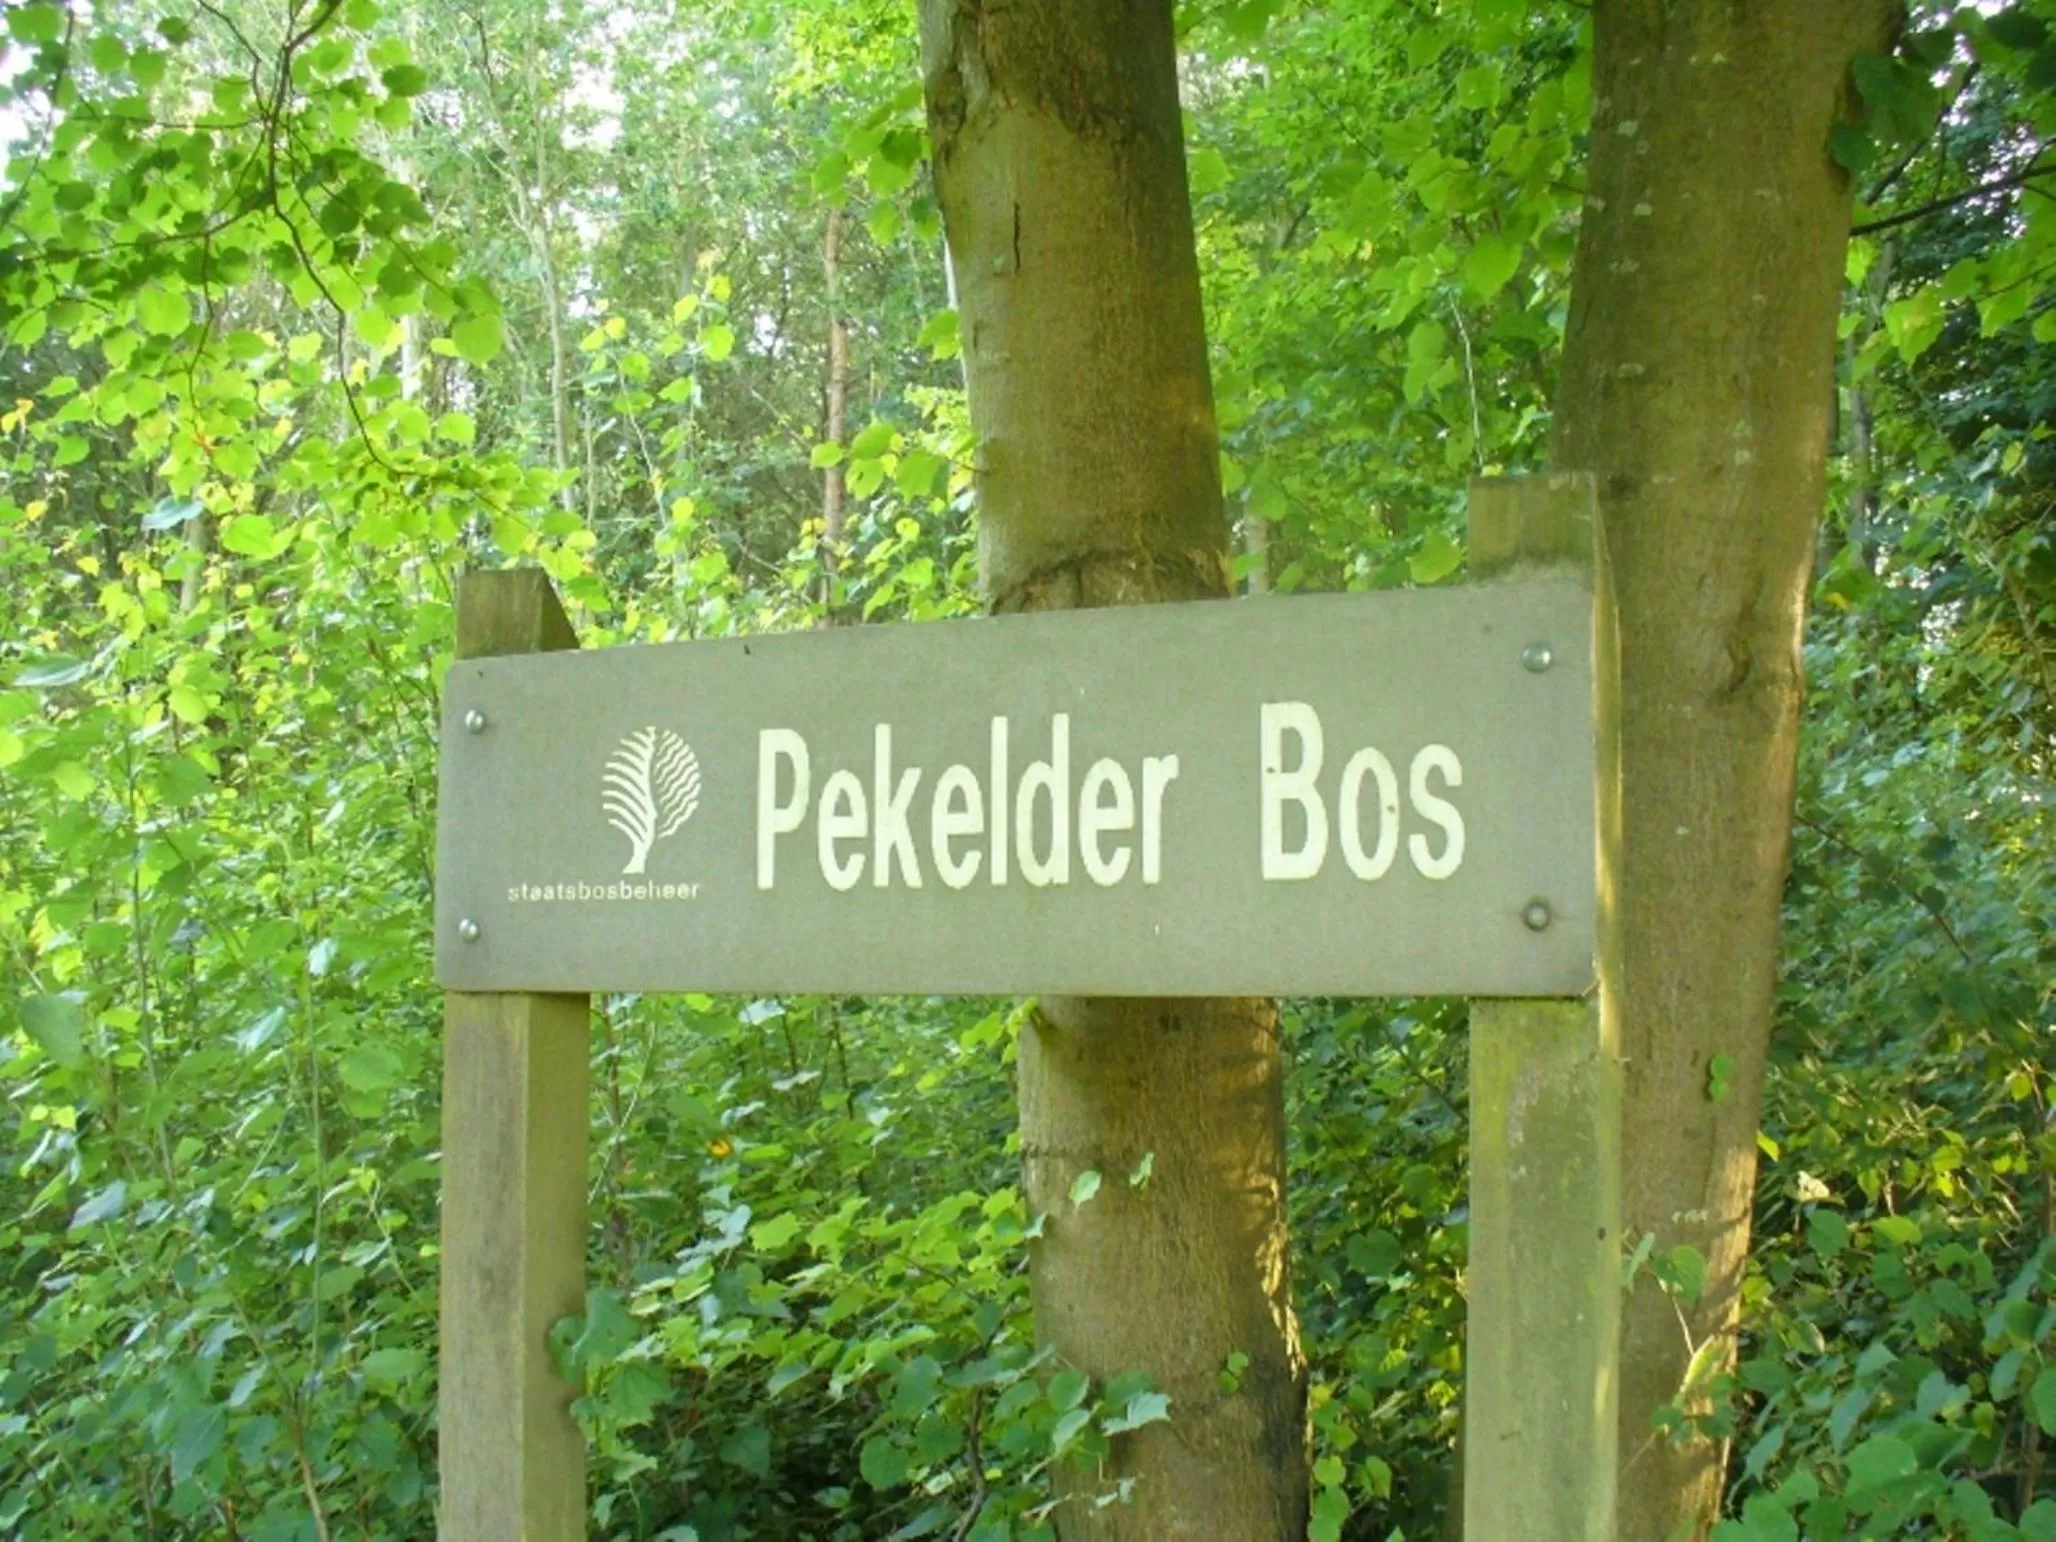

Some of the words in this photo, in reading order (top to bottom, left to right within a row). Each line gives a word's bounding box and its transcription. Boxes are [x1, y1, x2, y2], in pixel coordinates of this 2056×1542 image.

[757, 713, 1179, 890] Pekelder
[1260, 701, 1465, 881] Bos
[508, 880, 700, 902] staatsbosbeheer
